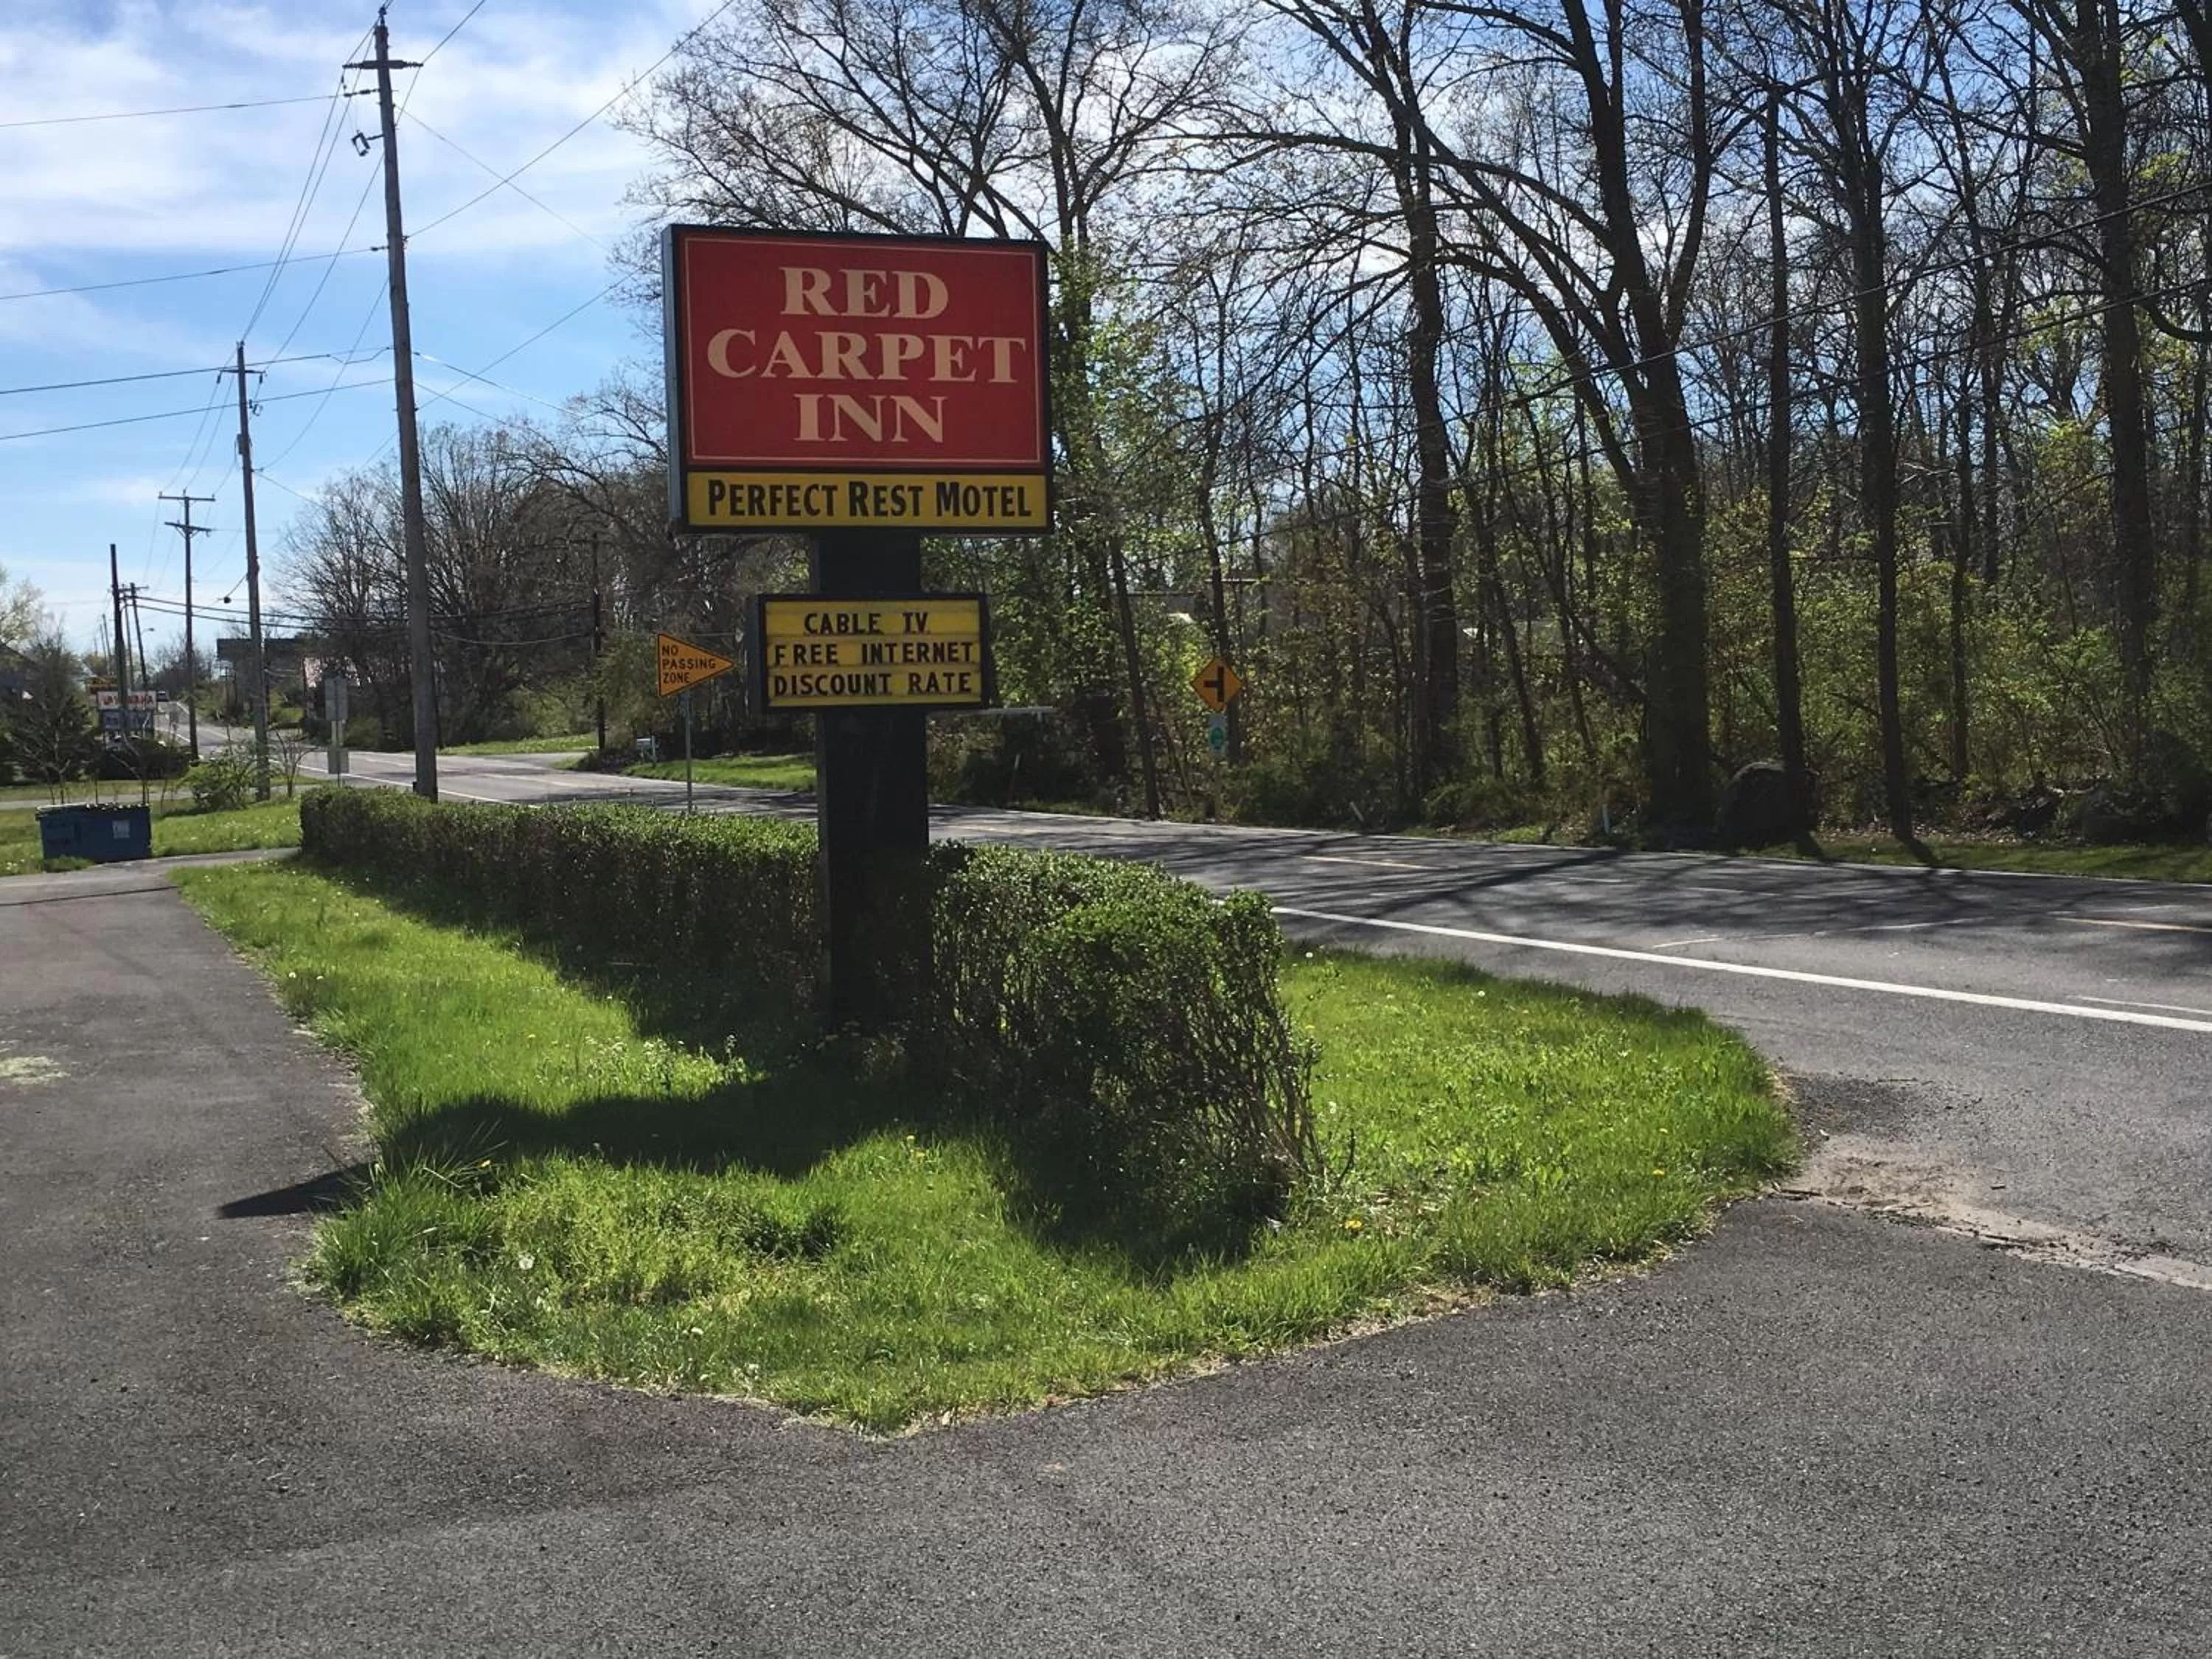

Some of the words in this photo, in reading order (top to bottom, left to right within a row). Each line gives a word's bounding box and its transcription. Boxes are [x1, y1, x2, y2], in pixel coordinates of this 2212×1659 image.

[779, 267, 948, 319] RED
[707, 329, 1026, 383] CARPET
[793, 394, 947, 442] INN
[708, 479, 838, 516] PERFECT
[849, 481, 923, 516] REST
[936, 482, 1032, 516] MOTEL
[804, 613, 882, 635] CABLE
[662, 645, 678, 655] NO
[775, 644, 838, 664] FREE
[862, 642, 973, 664] INTERNET
[662, 658, 716, 669] PASSING
[664, 672, 690, 684] ZONE
[775, 674, 892, 696] DISCOUNT
[908, 672, 971, 694] RATE
